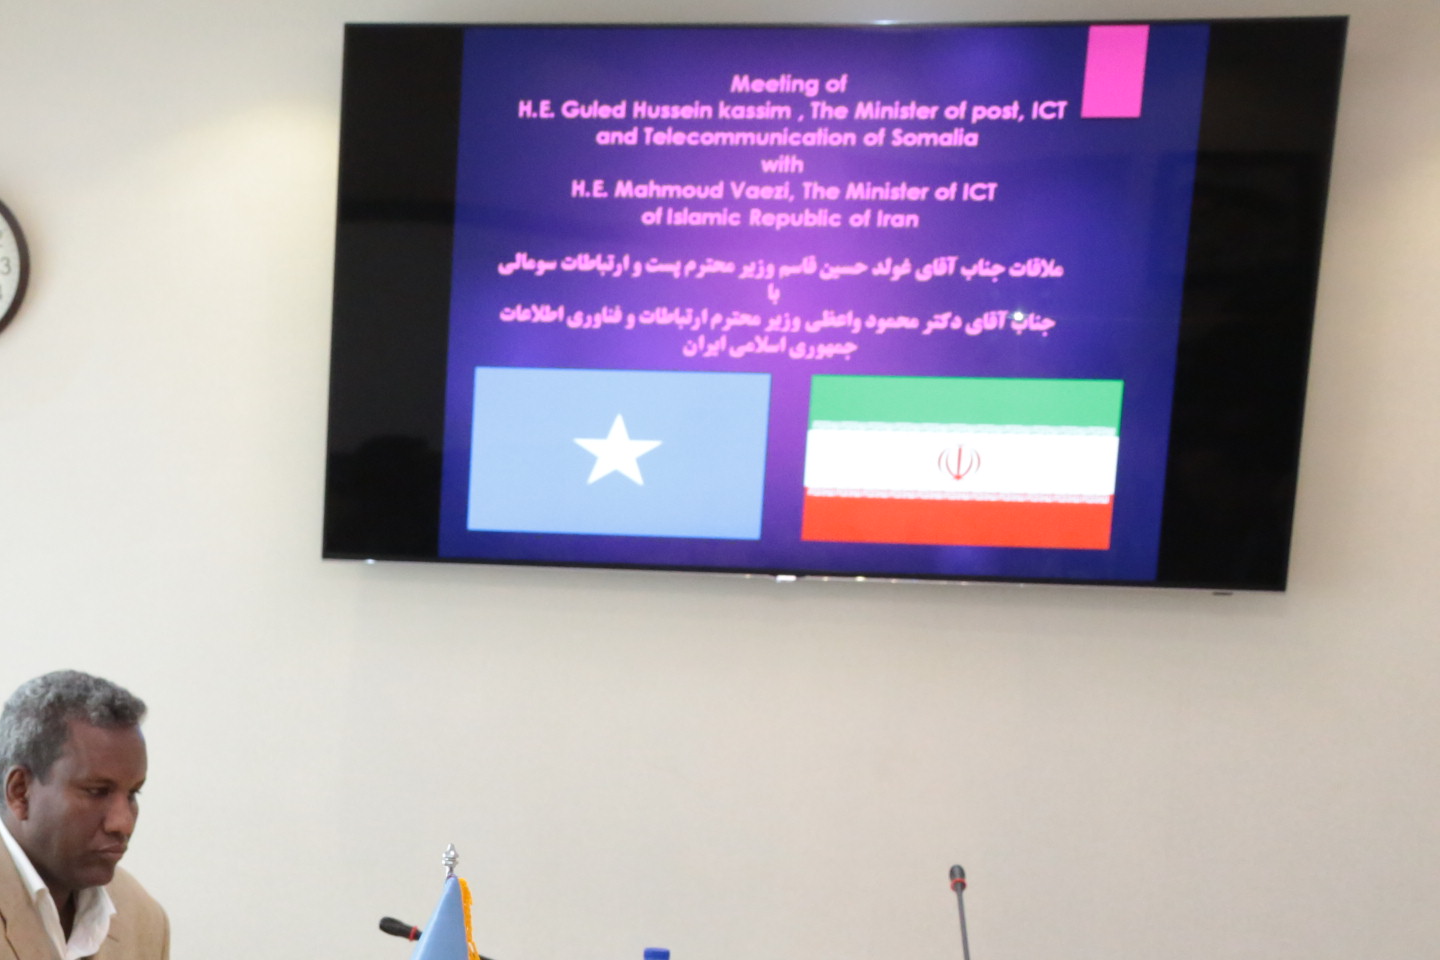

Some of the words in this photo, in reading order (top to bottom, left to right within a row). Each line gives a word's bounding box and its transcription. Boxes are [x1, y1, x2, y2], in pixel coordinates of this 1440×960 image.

[730, 74, 819, 97] Meeting
[825, 73, 848, 93] of
[518, 100, 555, 119] H.E.
[561, 99, 626, 119] Guled
[633, 100, 712, 119] Hussein
[718, 100, 791, 119] kassim
[810, 101, 848, 119] The
[854, 101, 939, 120] Minister
[944, 100, 967, 120] of
[971, 100, 1024, 124] post,
[1031, 100, 1068, 120] ICT
[595, 127, 638, 145] and
[644, 127, 856, 146] Telecommunication
[863, 128, 885, 147] of
[891, 128, 979, 147] Somalia
[761, 155, 804, 173] with
[571, 179, 608, 198] H.E.
[614, 180, 724, 199] Mahmoud
[730, 181, 794, 201] Vaezi,
[802, 181, 840, 200] The
[845, 181, 930, 201] Minister
[934, 181, 957, 201] of
[962, 182, 998, 201] ICT
[641, 207, 663, 226] of
[667, 208, 741, 226] Islamic
[749, 209, 841, 230] Republic
[849, 209, 871, 227] of
[877, 210, 919, 228] Iran
[0, 257, 11, 275] 3
[497, 252, 557, 276] سومالی
[560, 253, 629, 277] ارتباطات
[632, 261, 642, 277] و
[645, 258, 681, 279] پست
[684, 258, 735, 279] محترم
[738, 260, 775, 280] وزیر
[779, 255, 817, 279] قاسم
[819, 262, 868, 280] حسین
[915, 256, 958, 282] آقای
[960, 258, 1006, 283] جناب
[1008, 257, 1064, 278] ملاقات
[499, 304, 564, 323] اطلاعات
[566, 305, 623, 329] فناوری
[625, 313, 635, 329] و
[639, 307, 708, 330] ارتباطات
[711, 311, 761, 331] محترم
[765, 313, 801, 332] وزیر
[805, 310, 862, 334] واعظی
[865, 314, 919, 334] محمود
[922, 312, 962, 335] دکتر
[965, 310, 1009, 336] آقای
[682, 333, 726, 357] ایران
[729, 334, 786, 358] اسلامی
[789, 340, 858, 360] جمهوری
